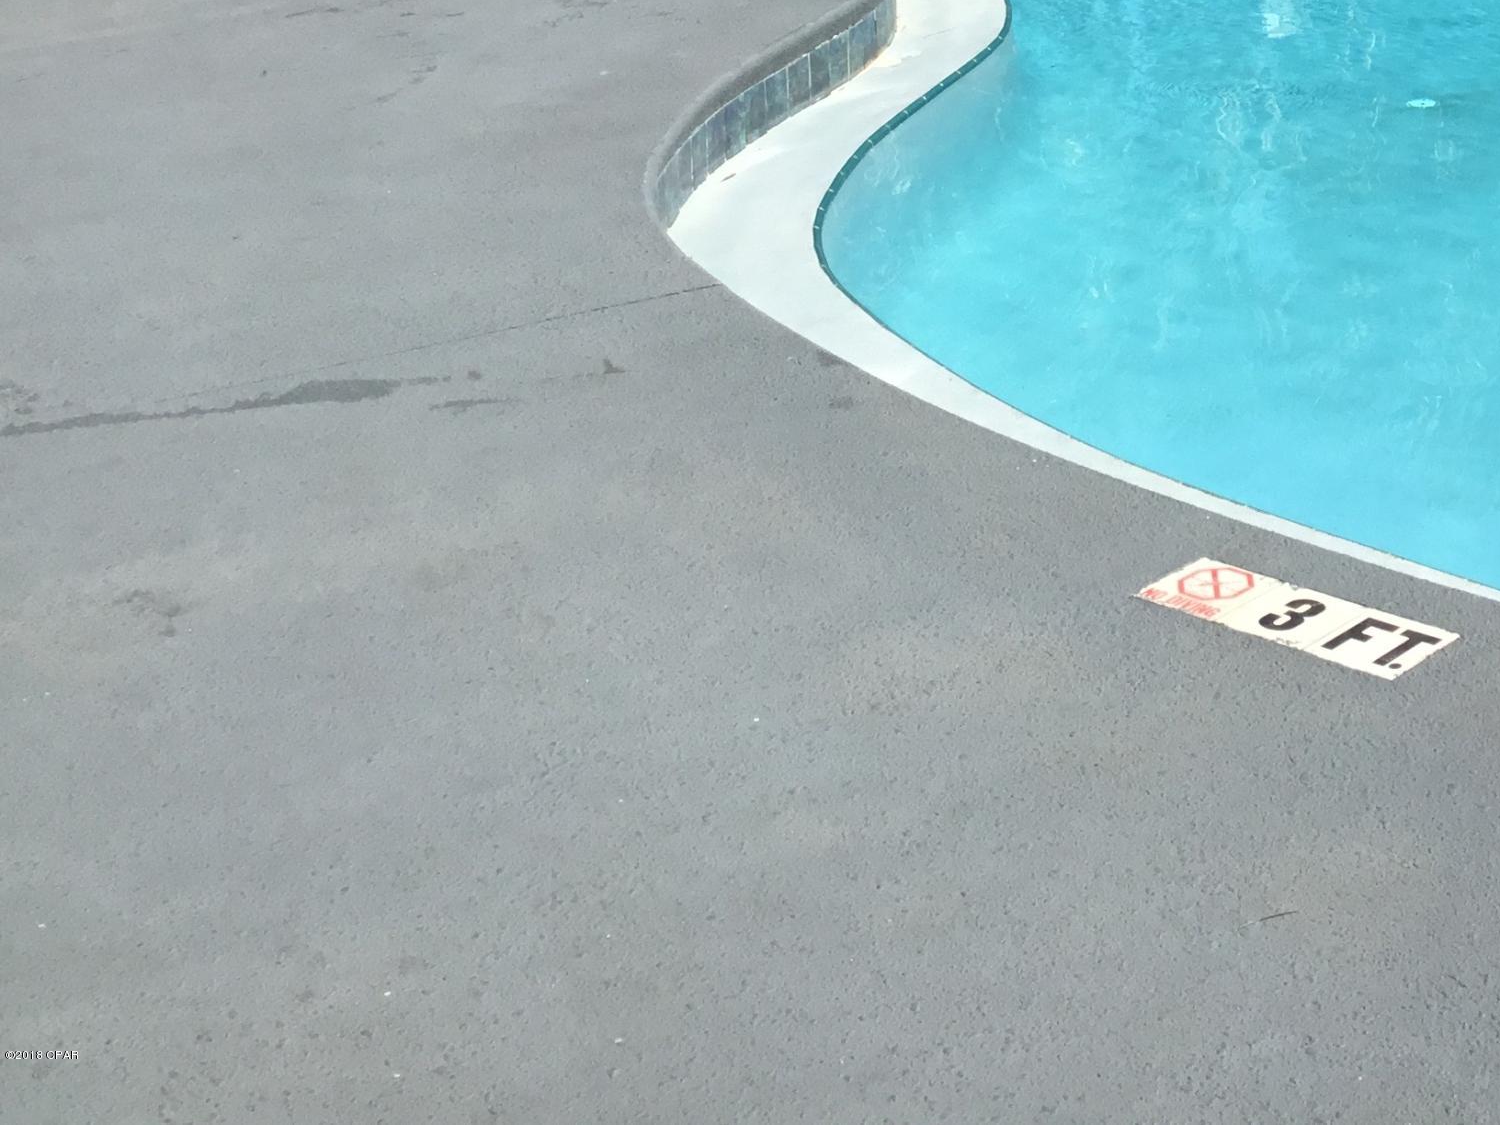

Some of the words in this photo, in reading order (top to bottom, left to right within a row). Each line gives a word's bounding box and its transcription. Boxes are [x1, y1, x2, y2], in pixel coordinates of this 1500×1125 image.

[1141, 587, 1168, 601] NO
[1166, 594, 1221, 618] DIVING
[1258, 598, 1326, 631] 3
[1321, 617, 1443, 670] FT.
